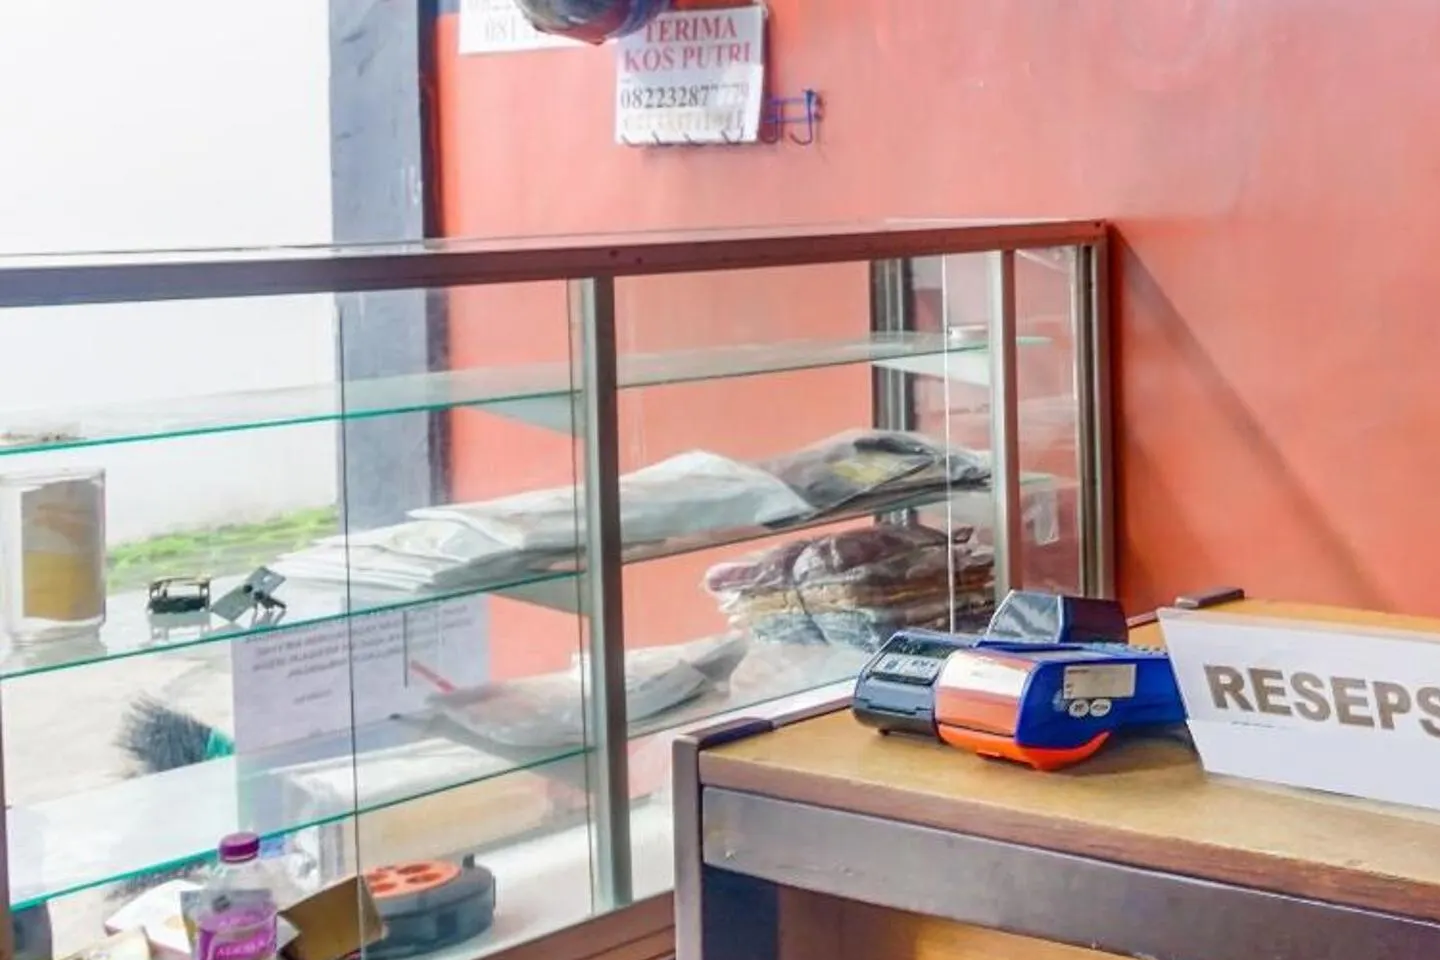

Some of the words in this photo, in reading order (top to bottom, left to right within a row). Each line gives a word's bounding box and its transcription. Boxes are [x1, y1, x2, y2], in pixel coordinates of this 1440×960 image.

[645, 16, 738, 43] TERIMA
[624, 45, 676, 73] KOS
[682, 41, 751, 69] PUTRI
